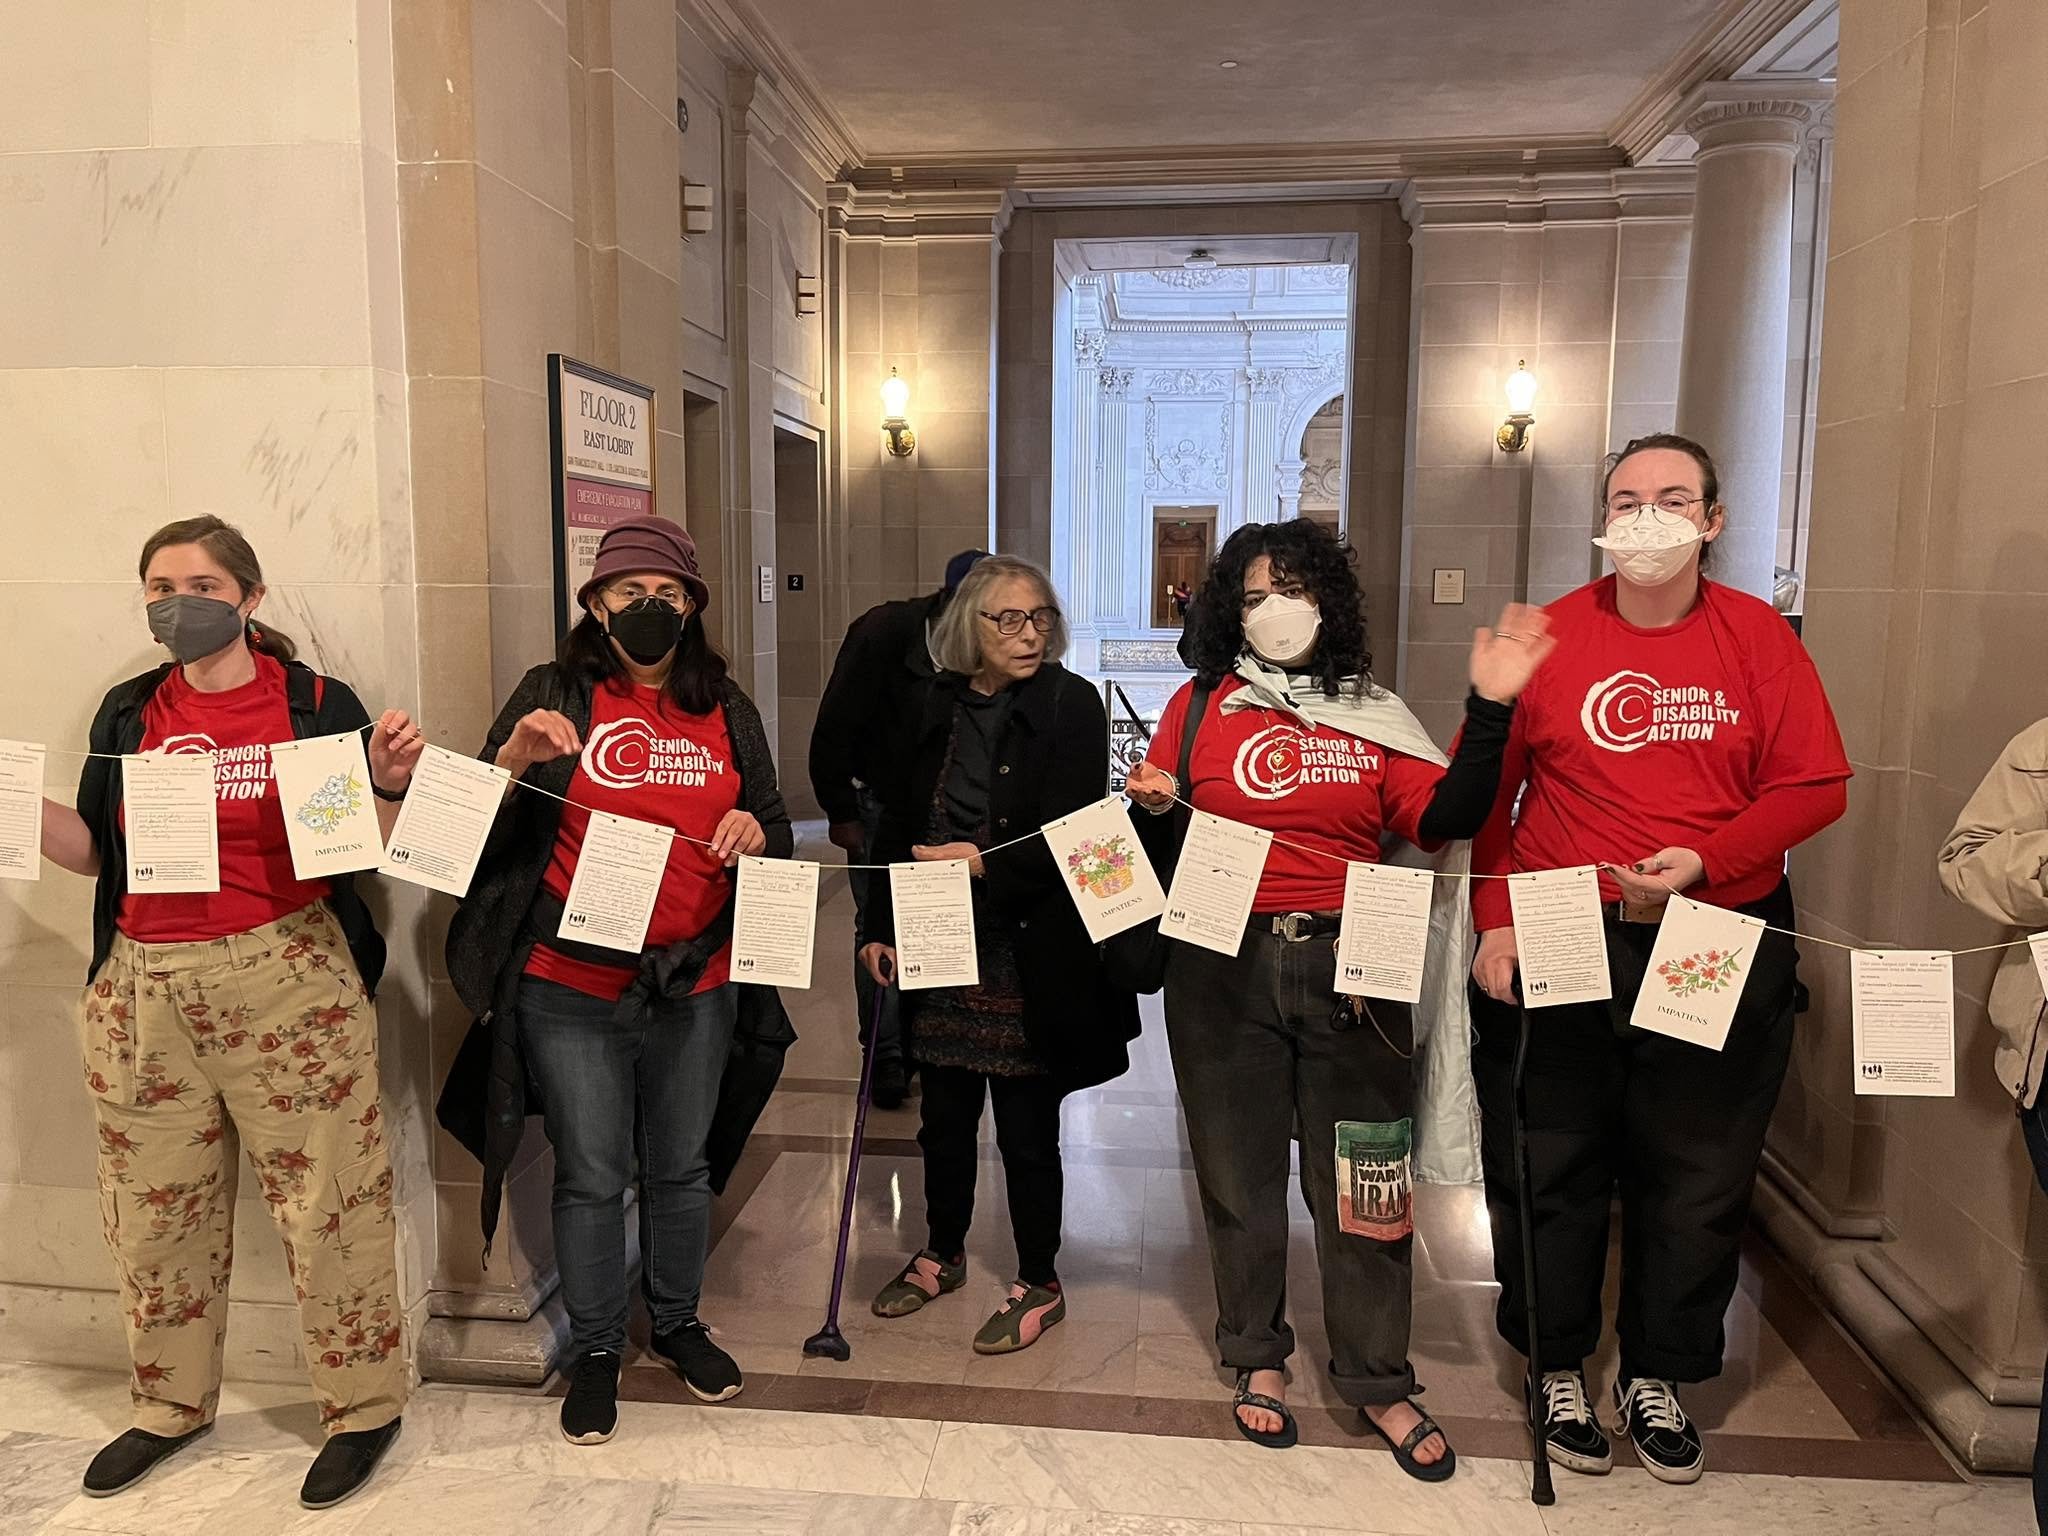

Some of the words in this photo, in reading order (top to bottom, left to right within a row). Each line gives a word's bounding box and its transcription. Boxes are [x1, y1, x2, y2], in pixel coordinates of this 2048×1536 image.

[580, 390, 628, 428] FLOOR
[629, 405, 637, 430] 2
[583, 429, 606, 450] EAST
[607, 435, 634, 456] LOBBY
[792, 576, 799, 587] 2
[1652, 686, 1710, 706] SENIOR
[1714, 690, 1726, 707] &
[1653, 704, 1740, 725] DISABILITY
[1646, 723, 1715, 742] ACTION
[208, 743, 267, 767] SENIOR
[649, 737, 701, 754] SENIOR
[700, 746, 712, 759] &
[1298, 736, 1351, 754] SENIOR
[1353, 740, 1365, 754] &
[649, 753, 724, 775] DISABILITY
[1300, 751, 1379, 770] DISABILITY
[643, 769, 706, 787] ACTION
[1298, 767, 1360, 784] ACTION
[315, 842, 363, 857] IMPATIENS
[1101, 896, 1143, 918] IMPATIENS
[1658, 1005, 1708, 1025] IMPATIENS
[1357, 1151, 1391, 1168] STOP
[1358, 1168, 1396, 1183] WAR
[1359, 1181, 1405, 1217] IRAN
